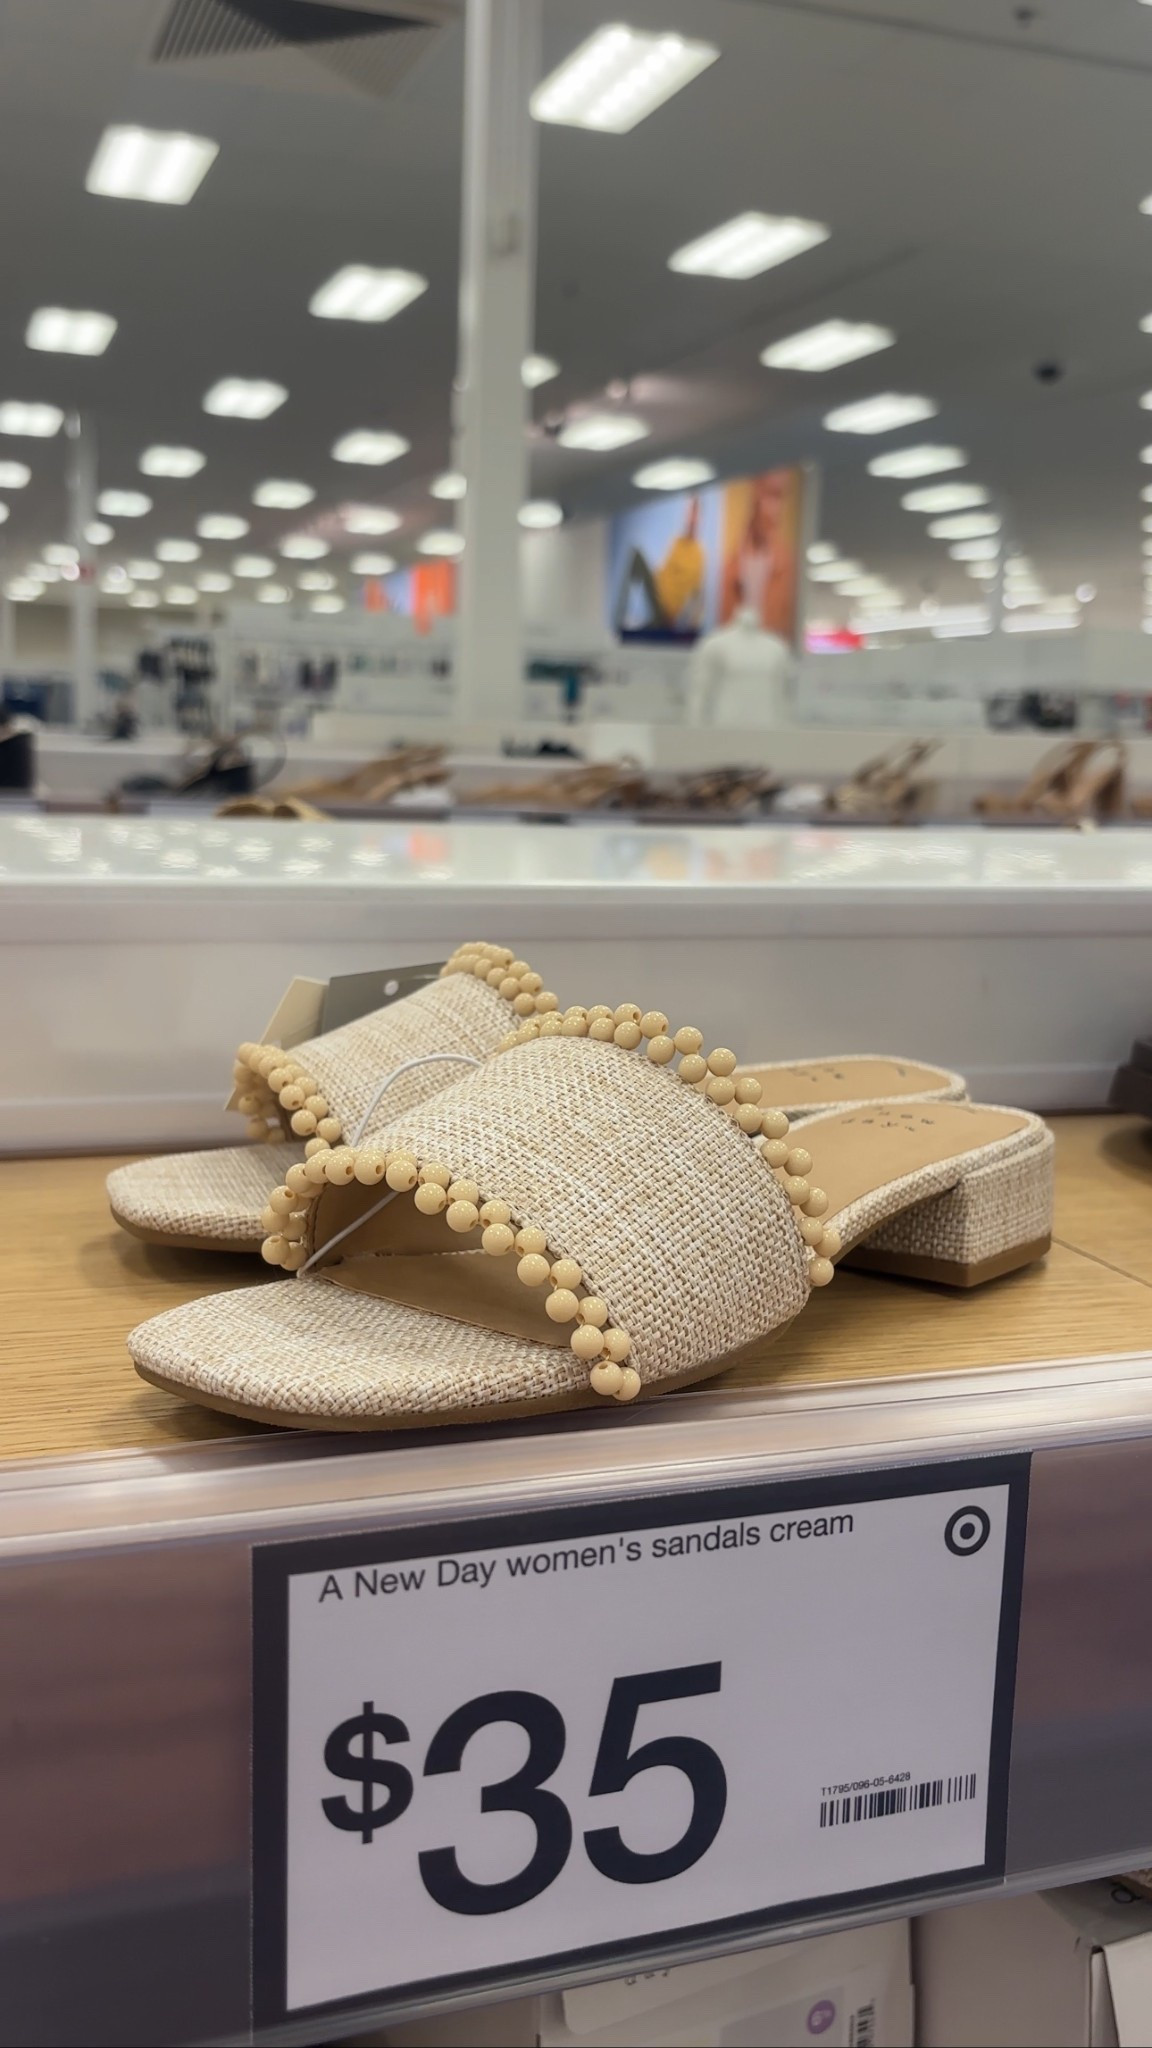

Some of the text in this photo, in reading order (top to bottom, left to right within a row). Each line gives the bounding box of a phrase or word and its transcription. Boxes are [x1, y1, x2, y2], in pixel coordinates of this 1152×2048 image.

[318, 1514, 854, 1603] A New Day women's sandals cream
[321, 1661, 728, 1917] $35
[821, 1771, 911, 1796] T1795/096-05-6428
